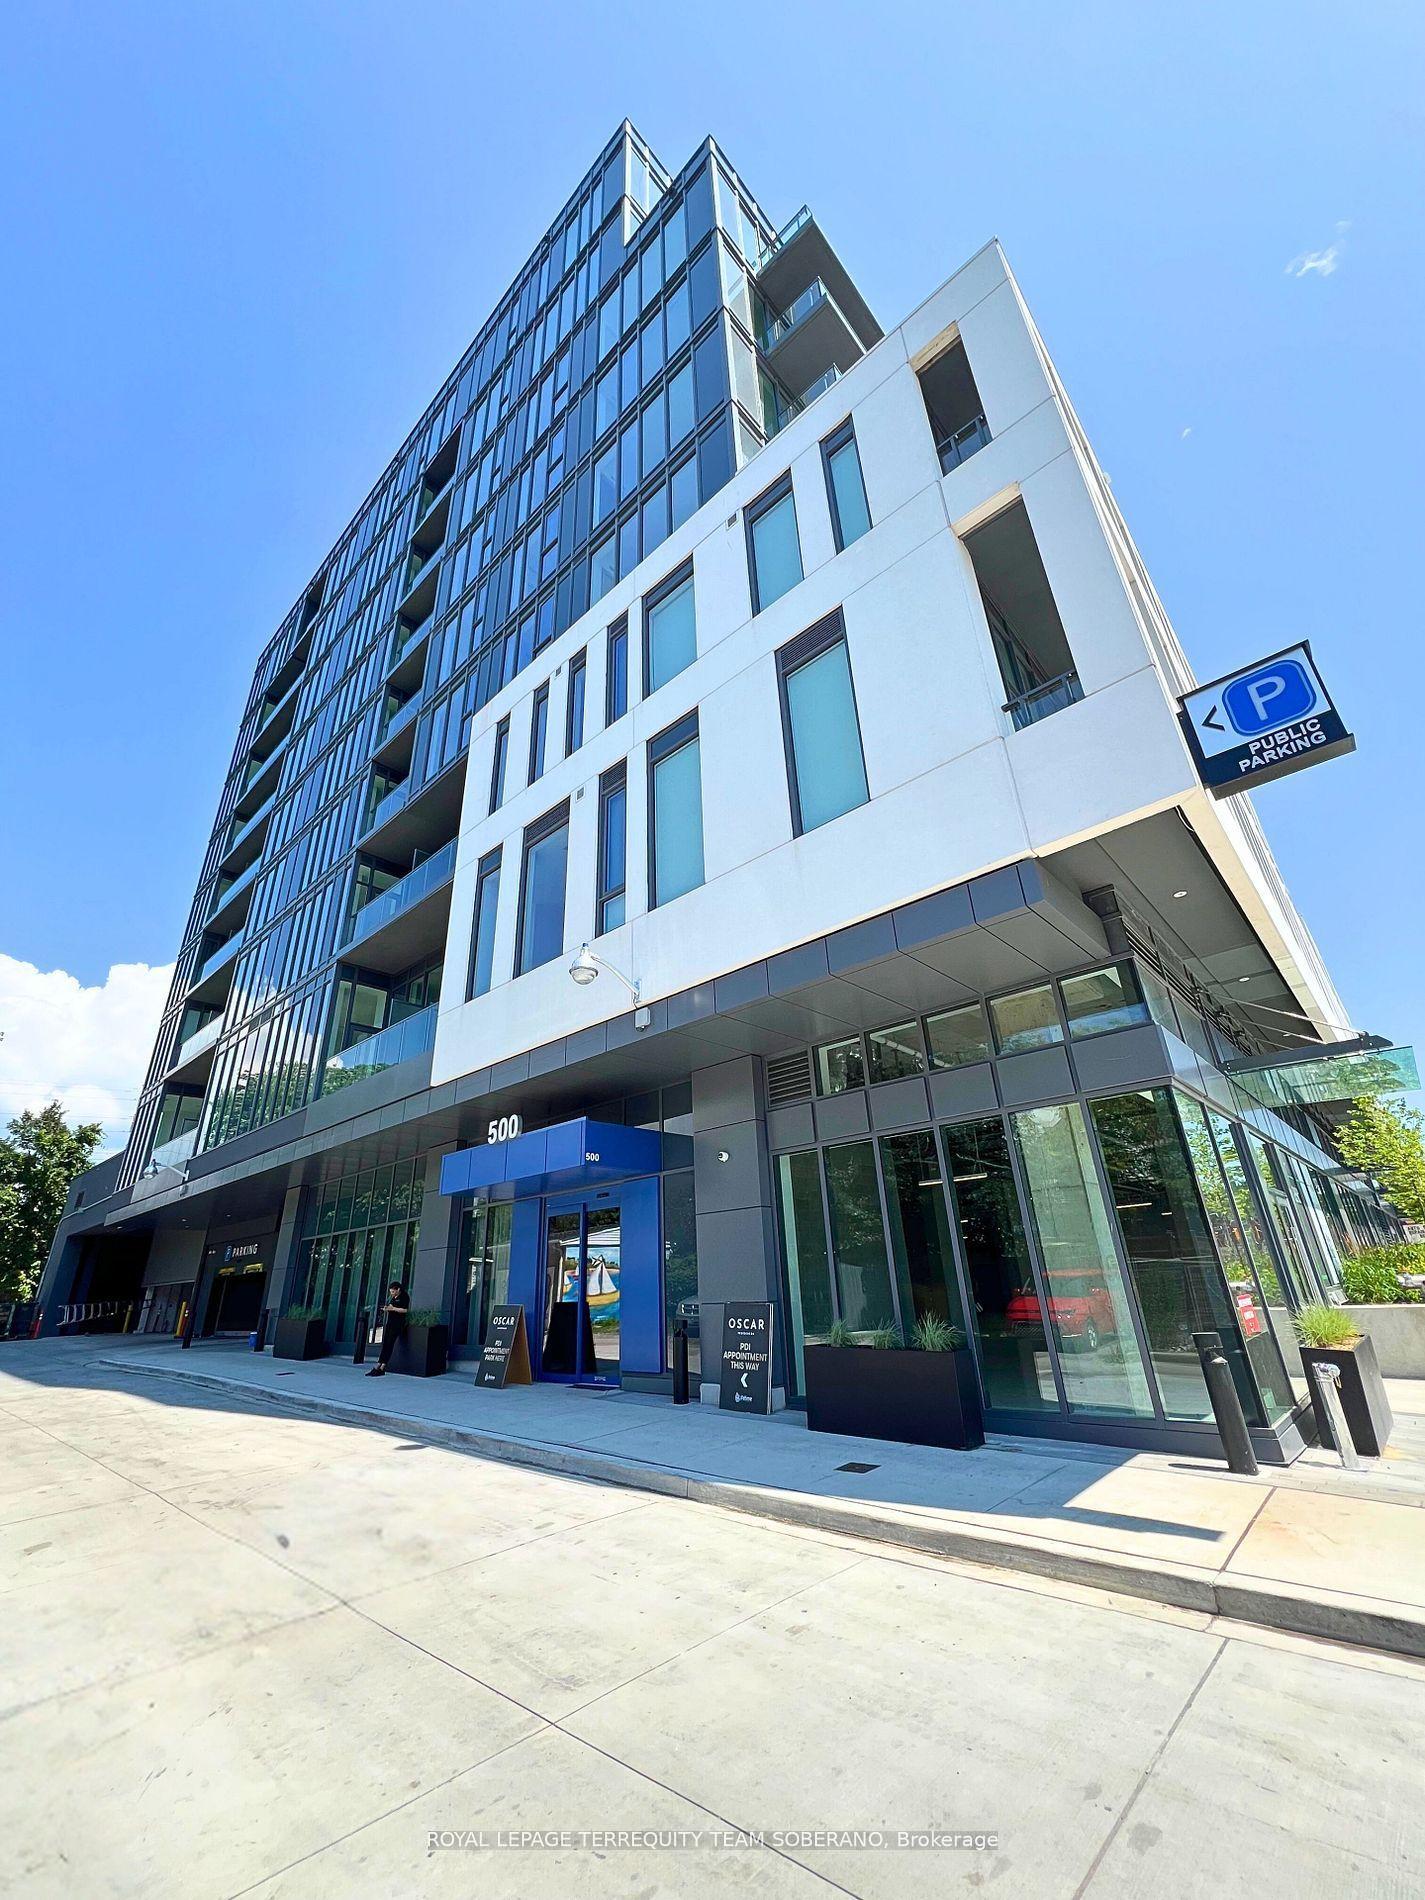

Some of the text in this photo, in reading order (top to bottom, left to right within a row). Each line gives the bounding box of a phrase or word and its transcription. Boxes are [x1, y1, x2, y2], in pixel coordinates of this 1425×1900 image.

[1247, 675, 1286, 721] P
[1249, 718, 1321, 755] PUBLIC
[1238, 731, 1327, 773] PARKING
[487, 1114, 520, 1145] 500
[585, 1152, 600, 1162] 500
[232, 1244, 258, 1257] PARKING
[493, 1316, 515, 1326] OSCAR
[728, 1317, 764, 1330] OSCAR
[483, 1346, 510, 1355] APPOINTMENT
[739, 1342, 751, 1351] PDI
[723, 1351, 767, 1361] APPOINTMENT
[730, 1360, 760, 1371] THIS WAY
